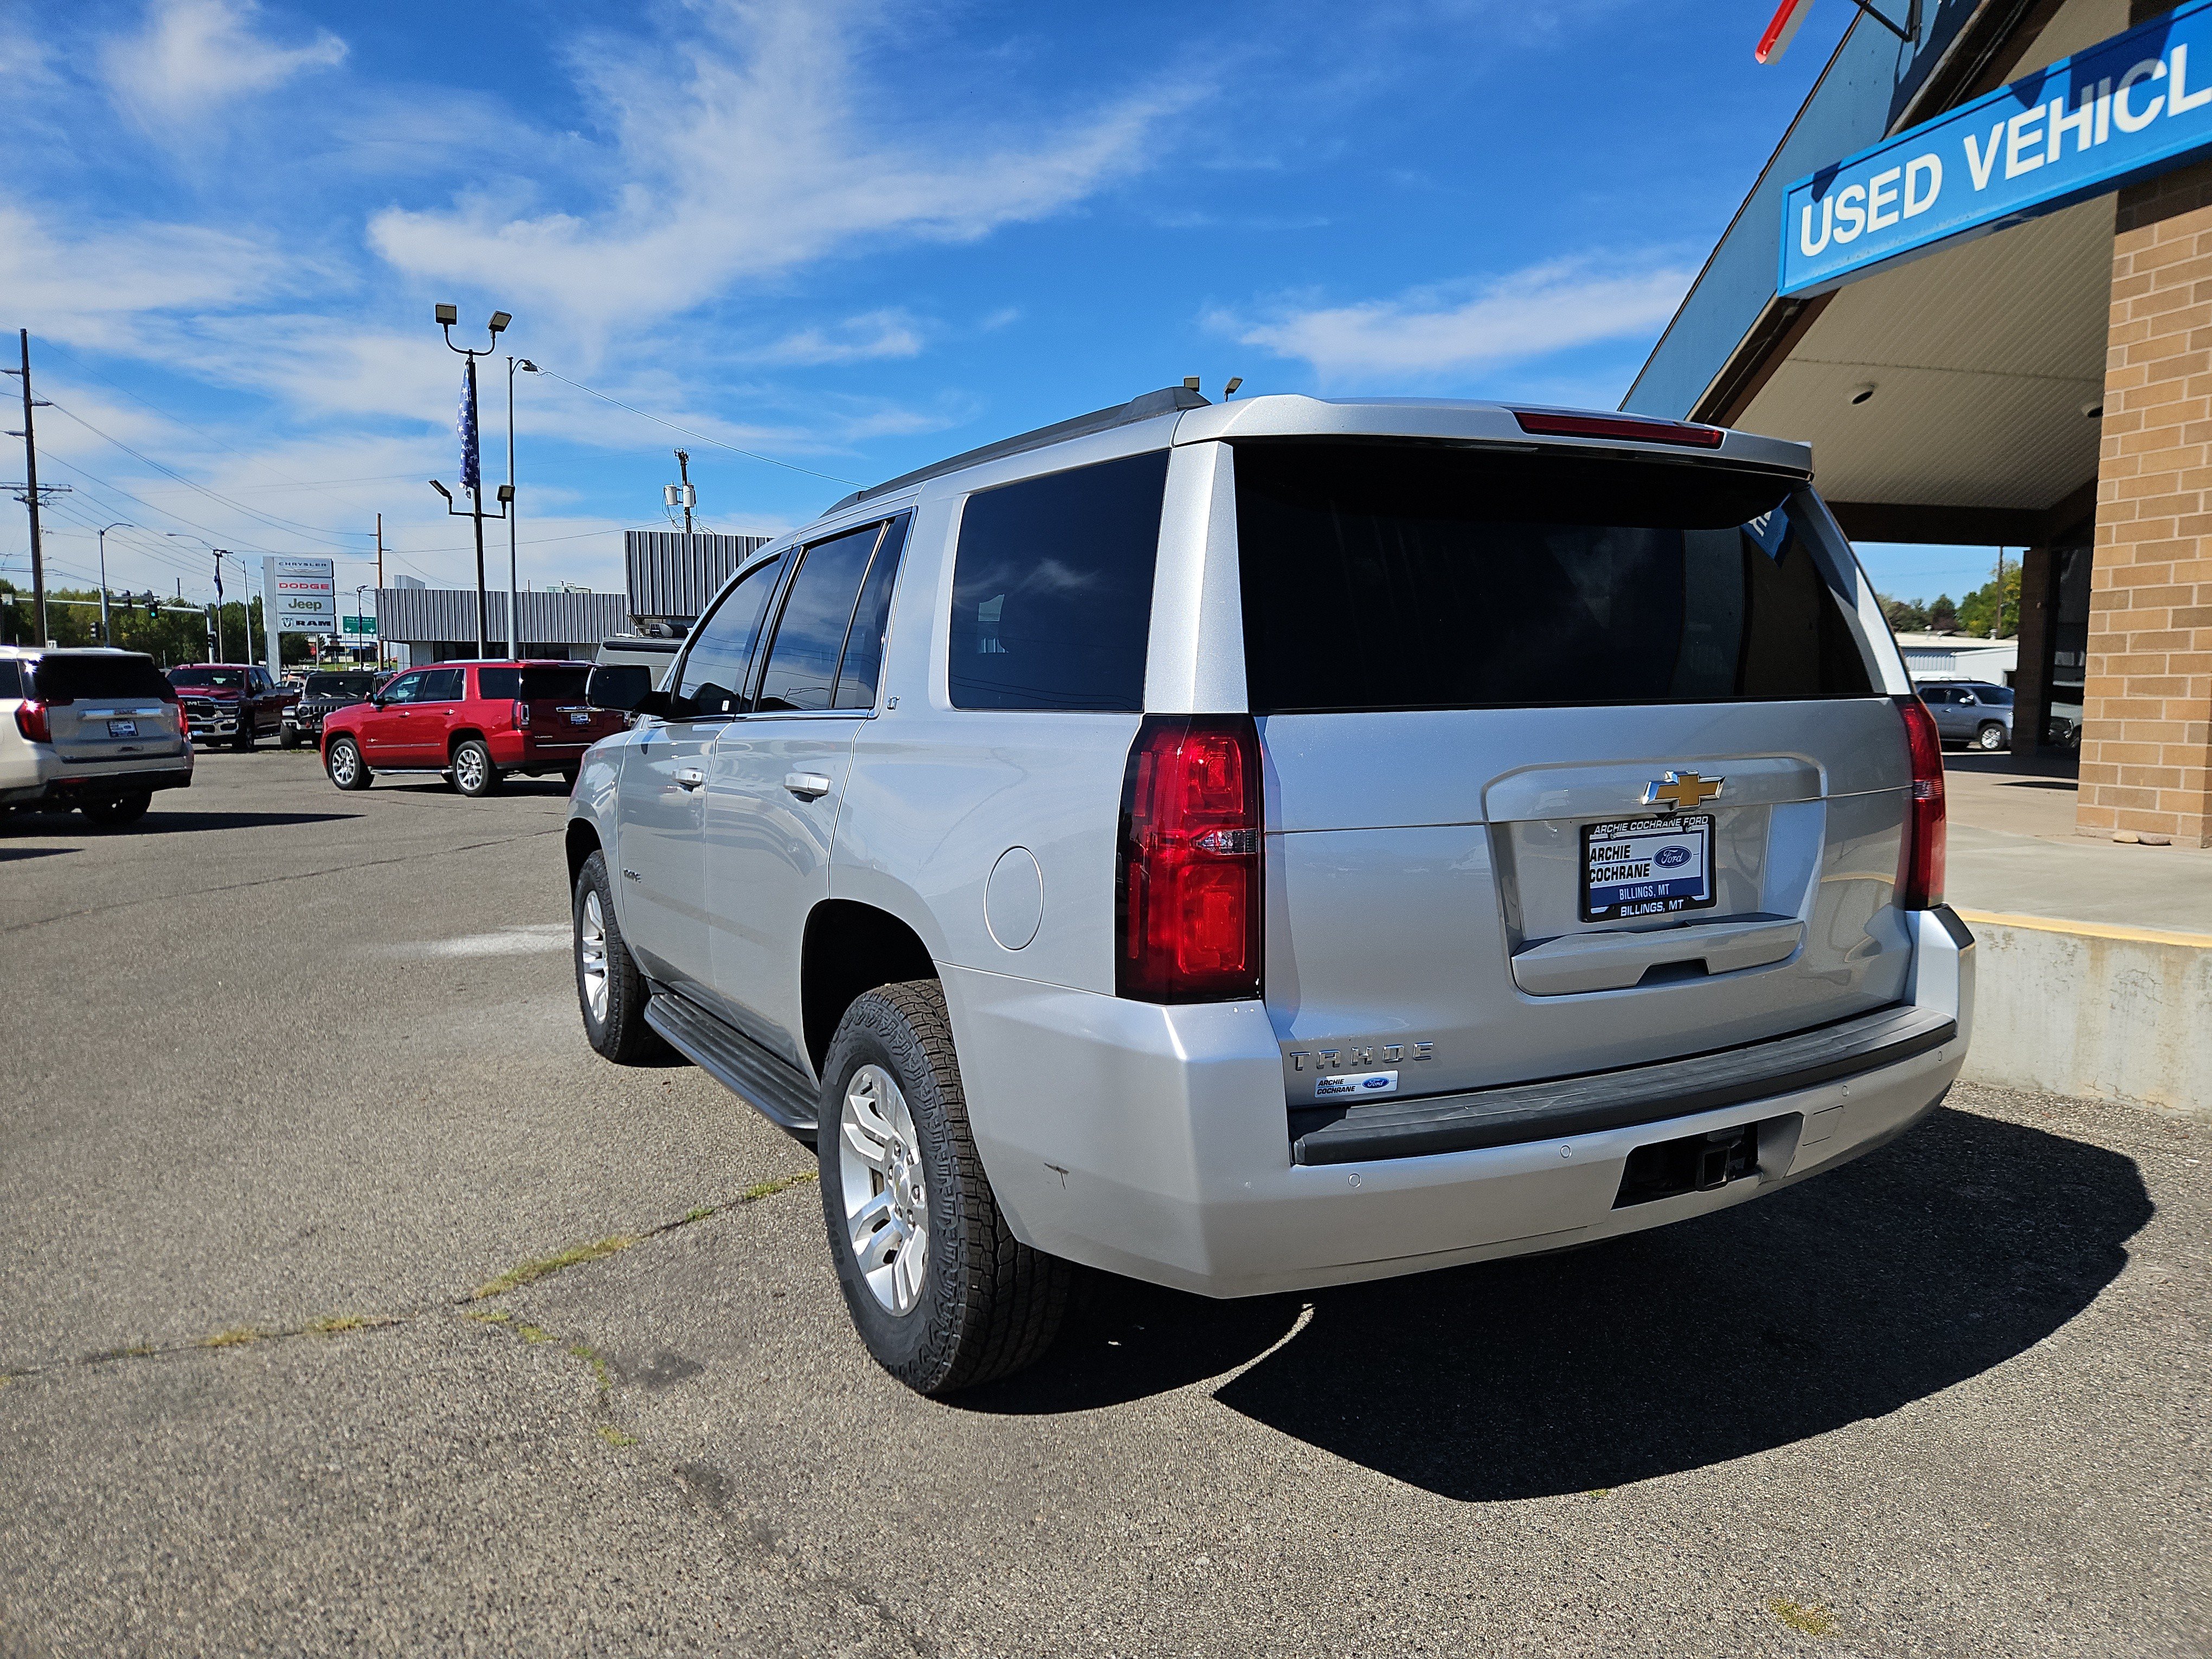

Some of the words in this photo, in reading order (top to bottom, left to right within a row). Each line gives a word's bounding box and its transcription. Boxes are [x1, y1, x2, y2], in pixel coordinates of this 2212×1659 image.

[1800, 153, 1943, 257] USED
[1963, 43, 2212, 191] VEHICL
[288, 598, 322, 612] Jeep
[1594, 822, 1628, 834] ARCHIE
[1630, 818, 1681, 831] COCHRANE
[1683, 816, 1708, 826] FORD
[1590, 844, 1631, 863] ARCHIE
[1661, 849, 1683, 864] Ford
[1590, 863, 1650, 883] COCHRANE
[1619, 885, 1656, 901] BILLINGS,
[1658, 883, 1670, 896] MT
[1620, 901, 1666, 917] BILLINGS,
[1669, 899, 1684, 910] MT
[1289, 1041, 1434, 1071] TAHOE
[1317, 1085, 1356, 1095] COCHRANE
[1318, 1078, 1345, 1086] ARCHIE
